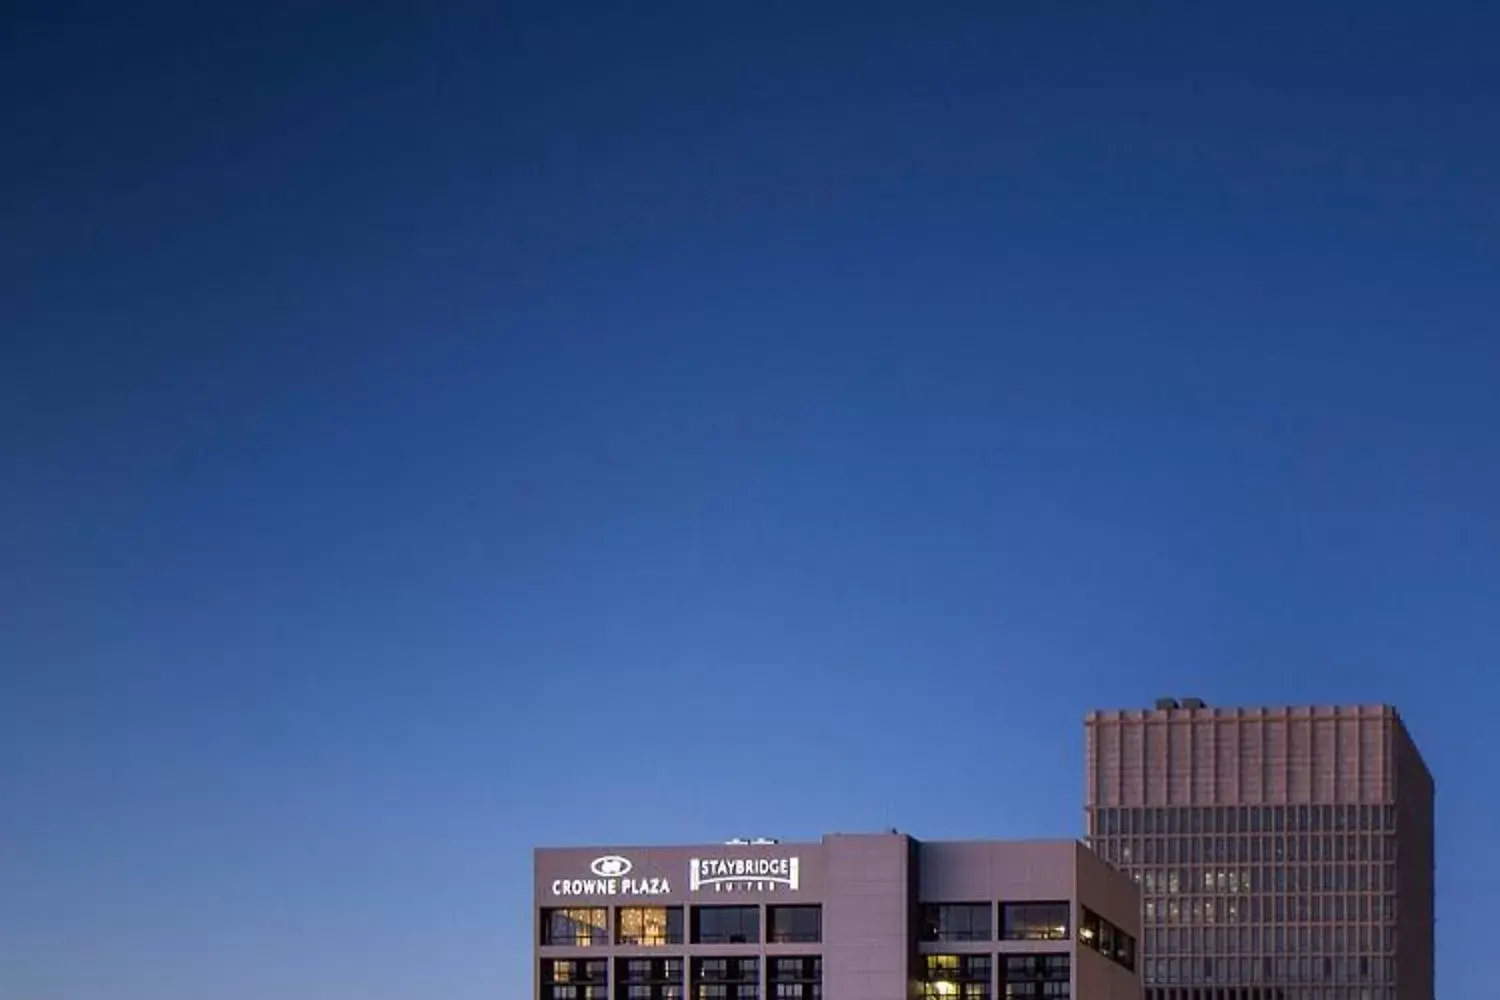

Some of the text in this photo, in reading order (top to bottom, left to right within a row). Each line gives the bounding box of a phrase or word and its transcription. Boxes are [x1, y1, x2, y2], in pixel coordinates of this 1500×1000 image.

[701, 859, 788, 875] STAYBRIDGE
[552, 877, 671, 895] CROWNE PLAZA
